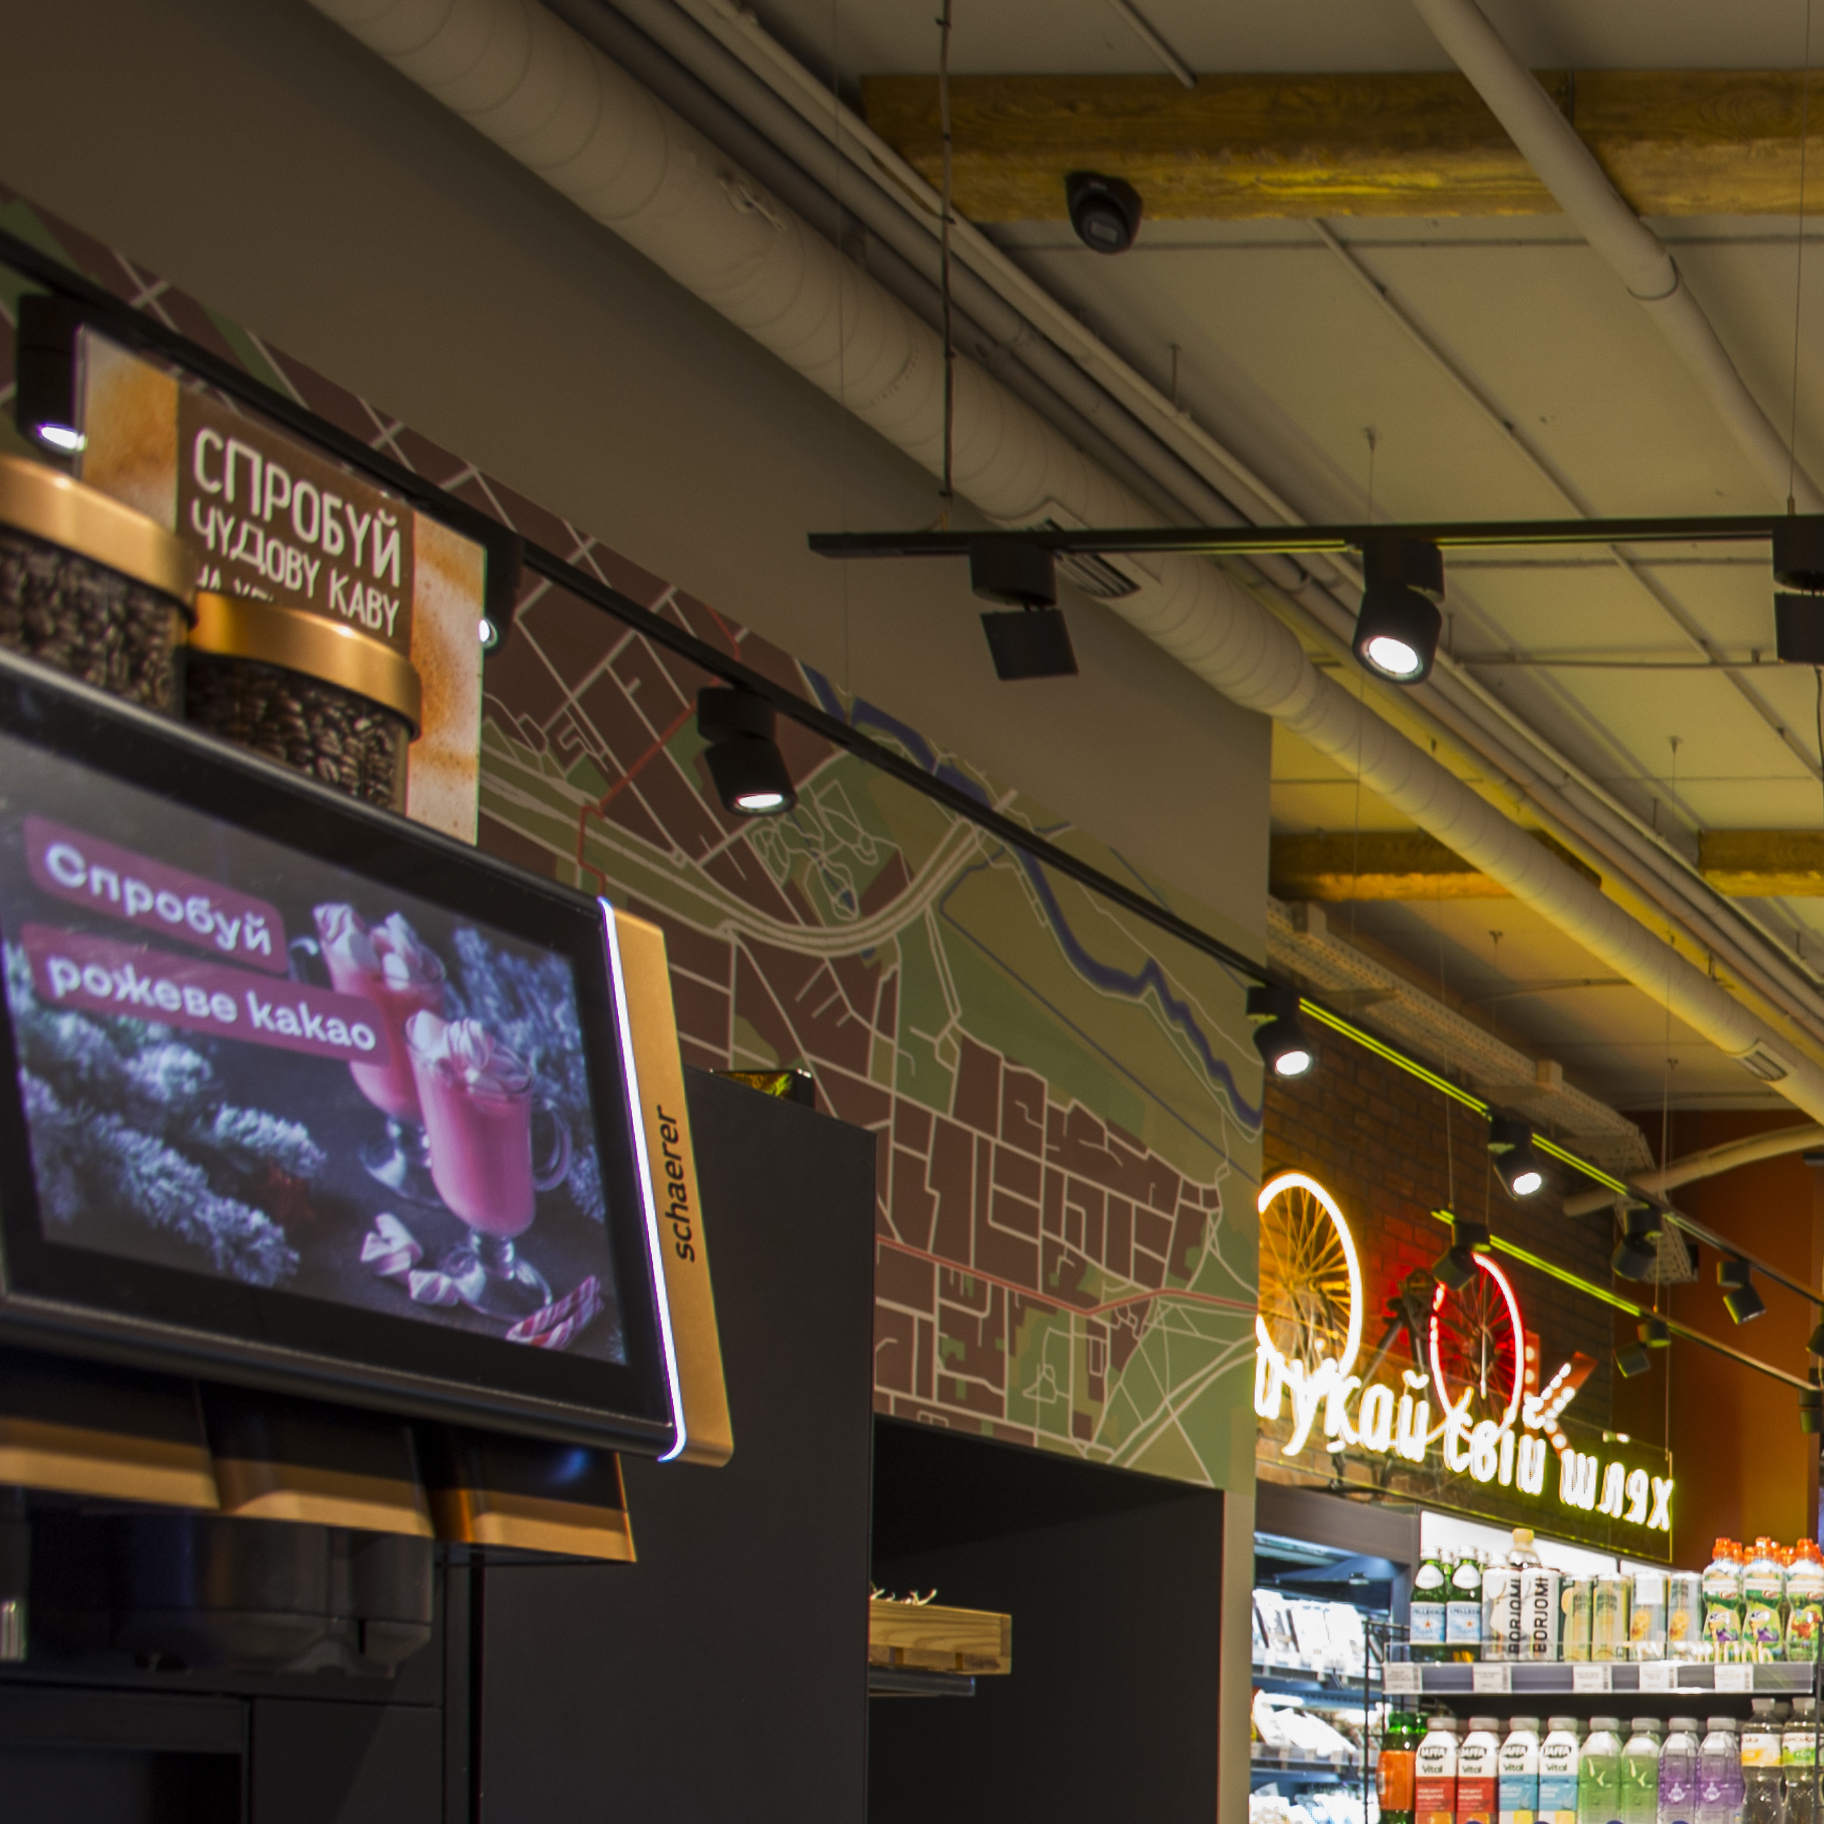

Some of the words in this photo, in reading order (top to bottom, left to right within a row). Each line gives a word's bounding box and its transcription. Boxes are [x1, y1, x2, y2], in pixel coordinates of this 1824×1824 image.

[194, 427, 400, 588] СПРОБУЙ
[191, 498, 320, 599] ЧУДОВУ
[329, 567, 399, 638] КАВУ
[44, 841, 273, 960] Спробуй
[49, 951, 238, 1025] рожеве
[657, 1105, 697, 1264] schaerer
[1559, 1448, 1675, 1532] шлях
[1533, 1577, 1549, 1654] BORJOMI
